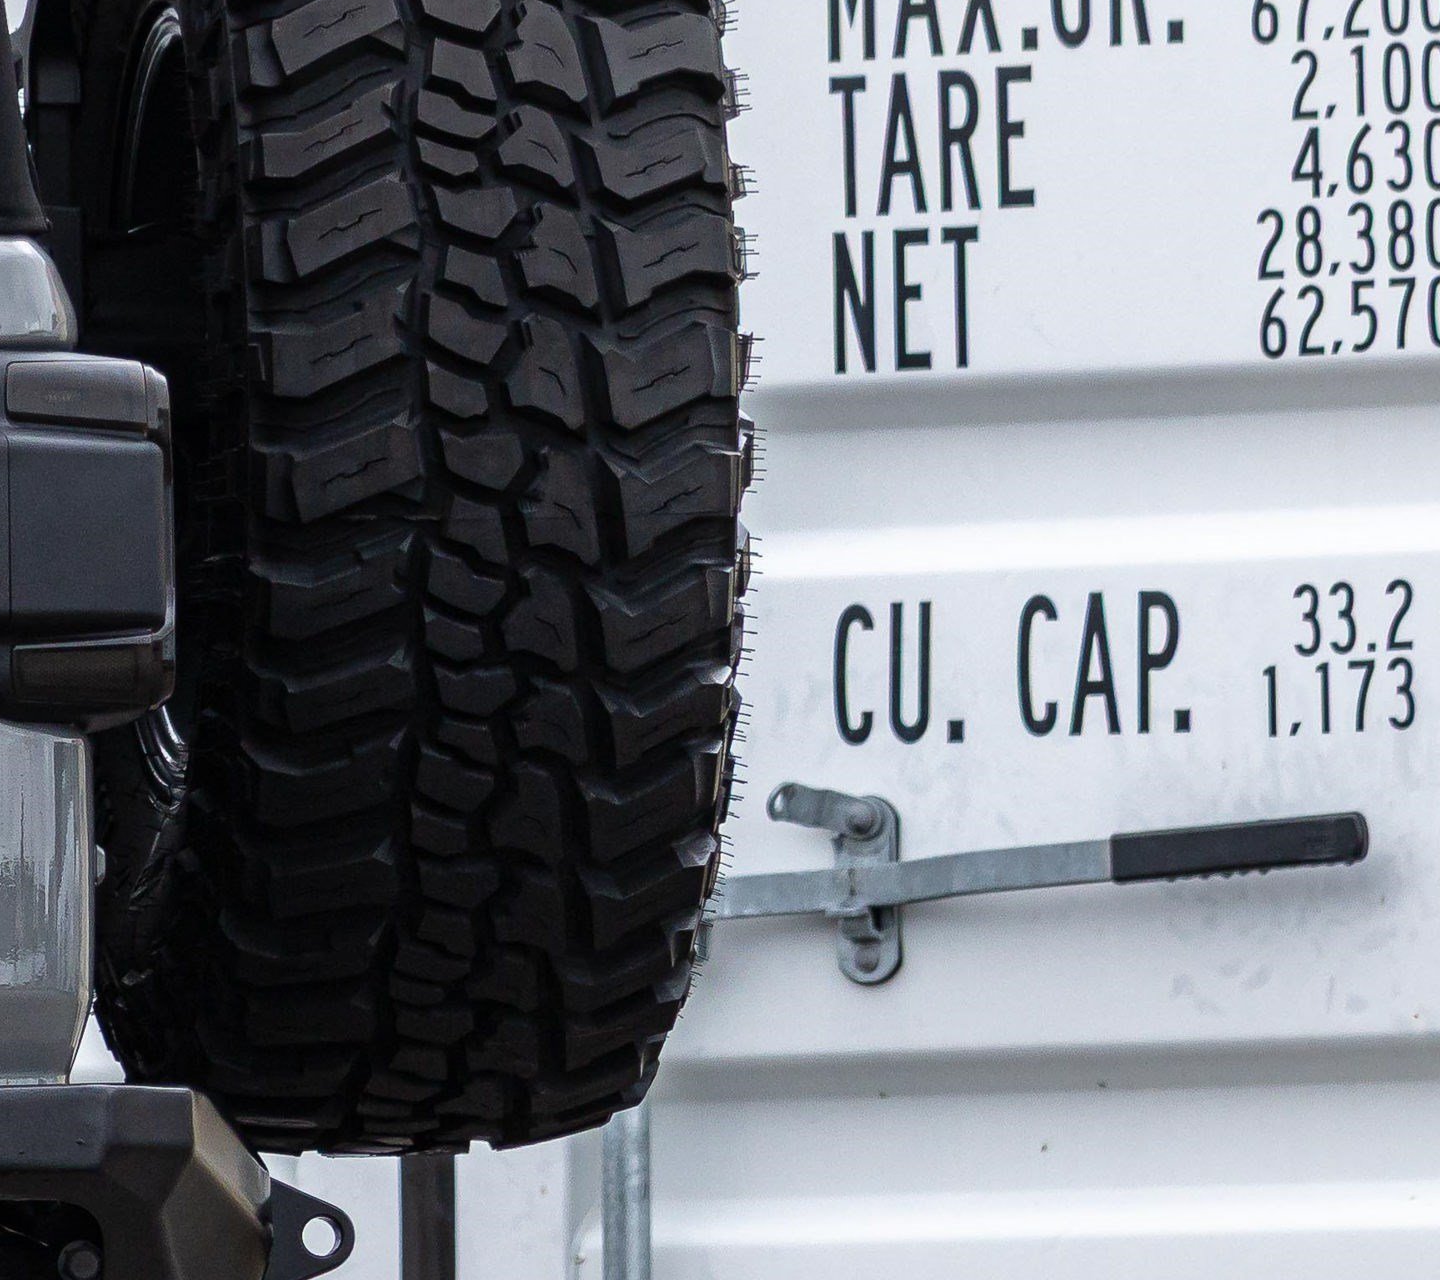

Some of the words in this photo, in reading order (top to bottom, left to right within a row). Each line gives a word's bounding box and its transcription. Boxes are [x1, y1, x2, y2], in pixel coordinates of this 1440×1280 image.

[829, 64, 1037, 218] TARE
[832, 225, 980, 375] NET
[832, 602, 964, 747] CU.
[1018, 588, 1192, 739] CAP.
[1292, 577, 1415, 658] 33.2
[1263, 656, 1417, 740] 1,173
